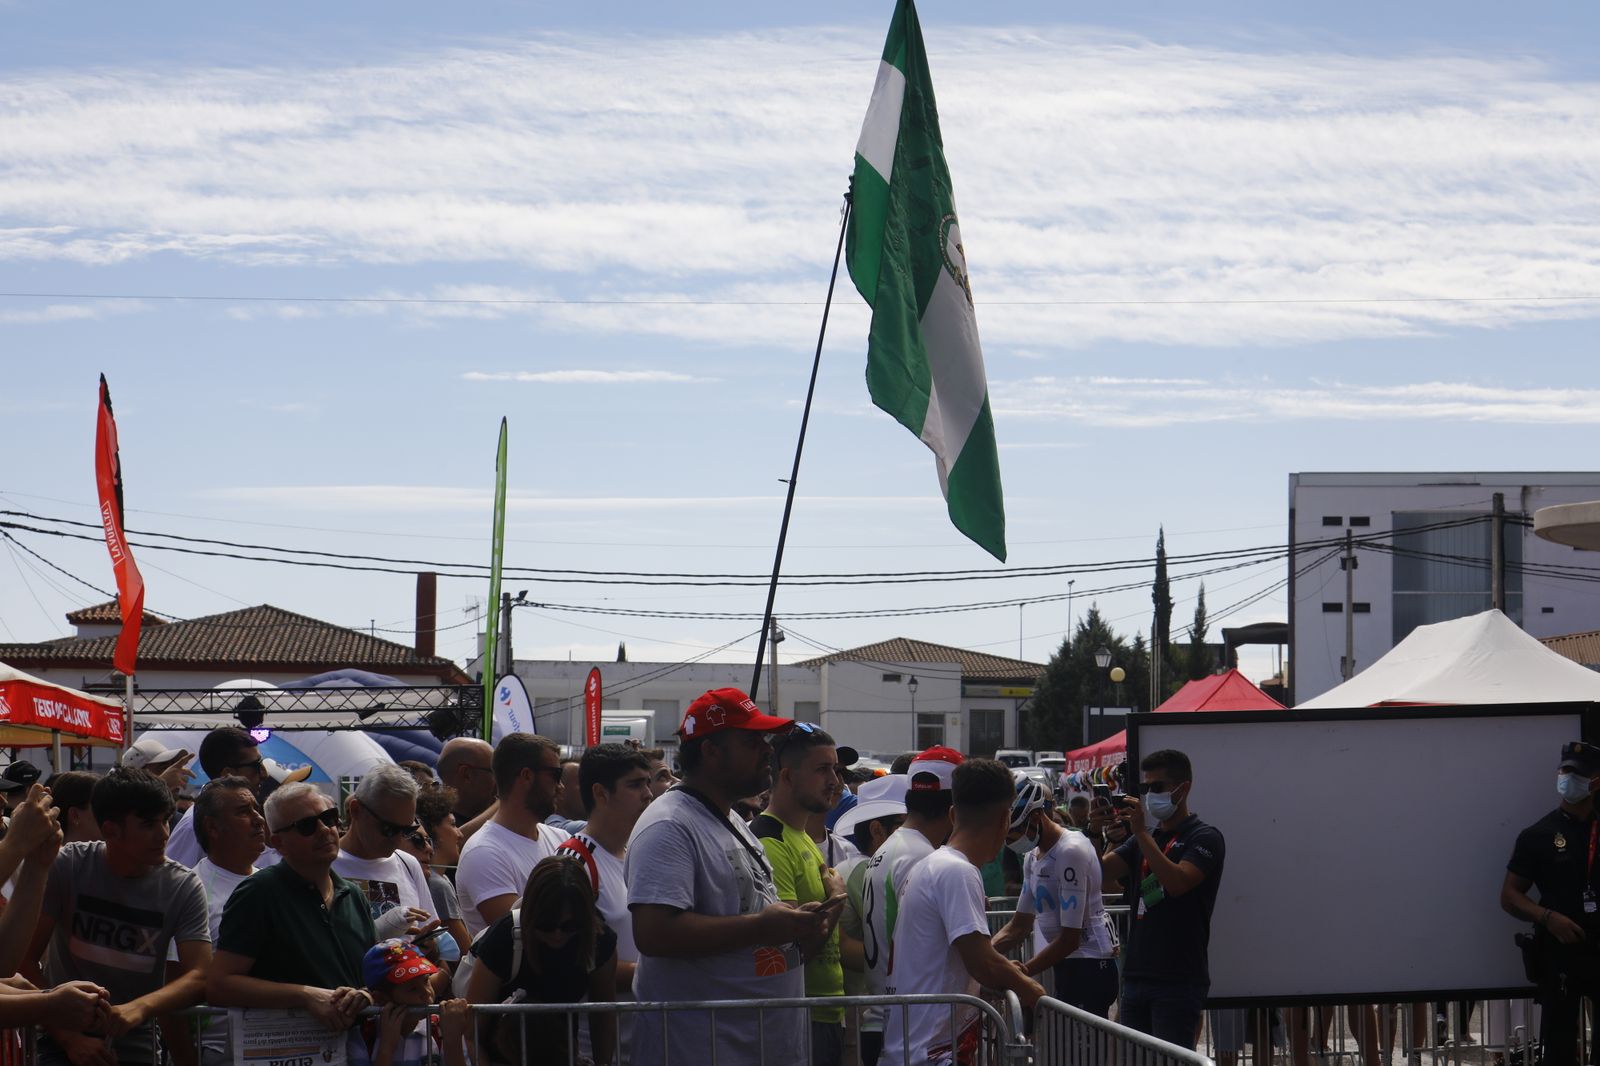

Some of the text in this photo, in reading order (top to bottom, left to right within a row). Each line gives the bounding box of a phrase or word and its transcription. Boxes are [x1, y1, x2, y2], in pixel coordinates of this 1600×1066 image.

[102, 508, 121, 559] LA VUELTA
[72, 911, 161, 955] NRGX
